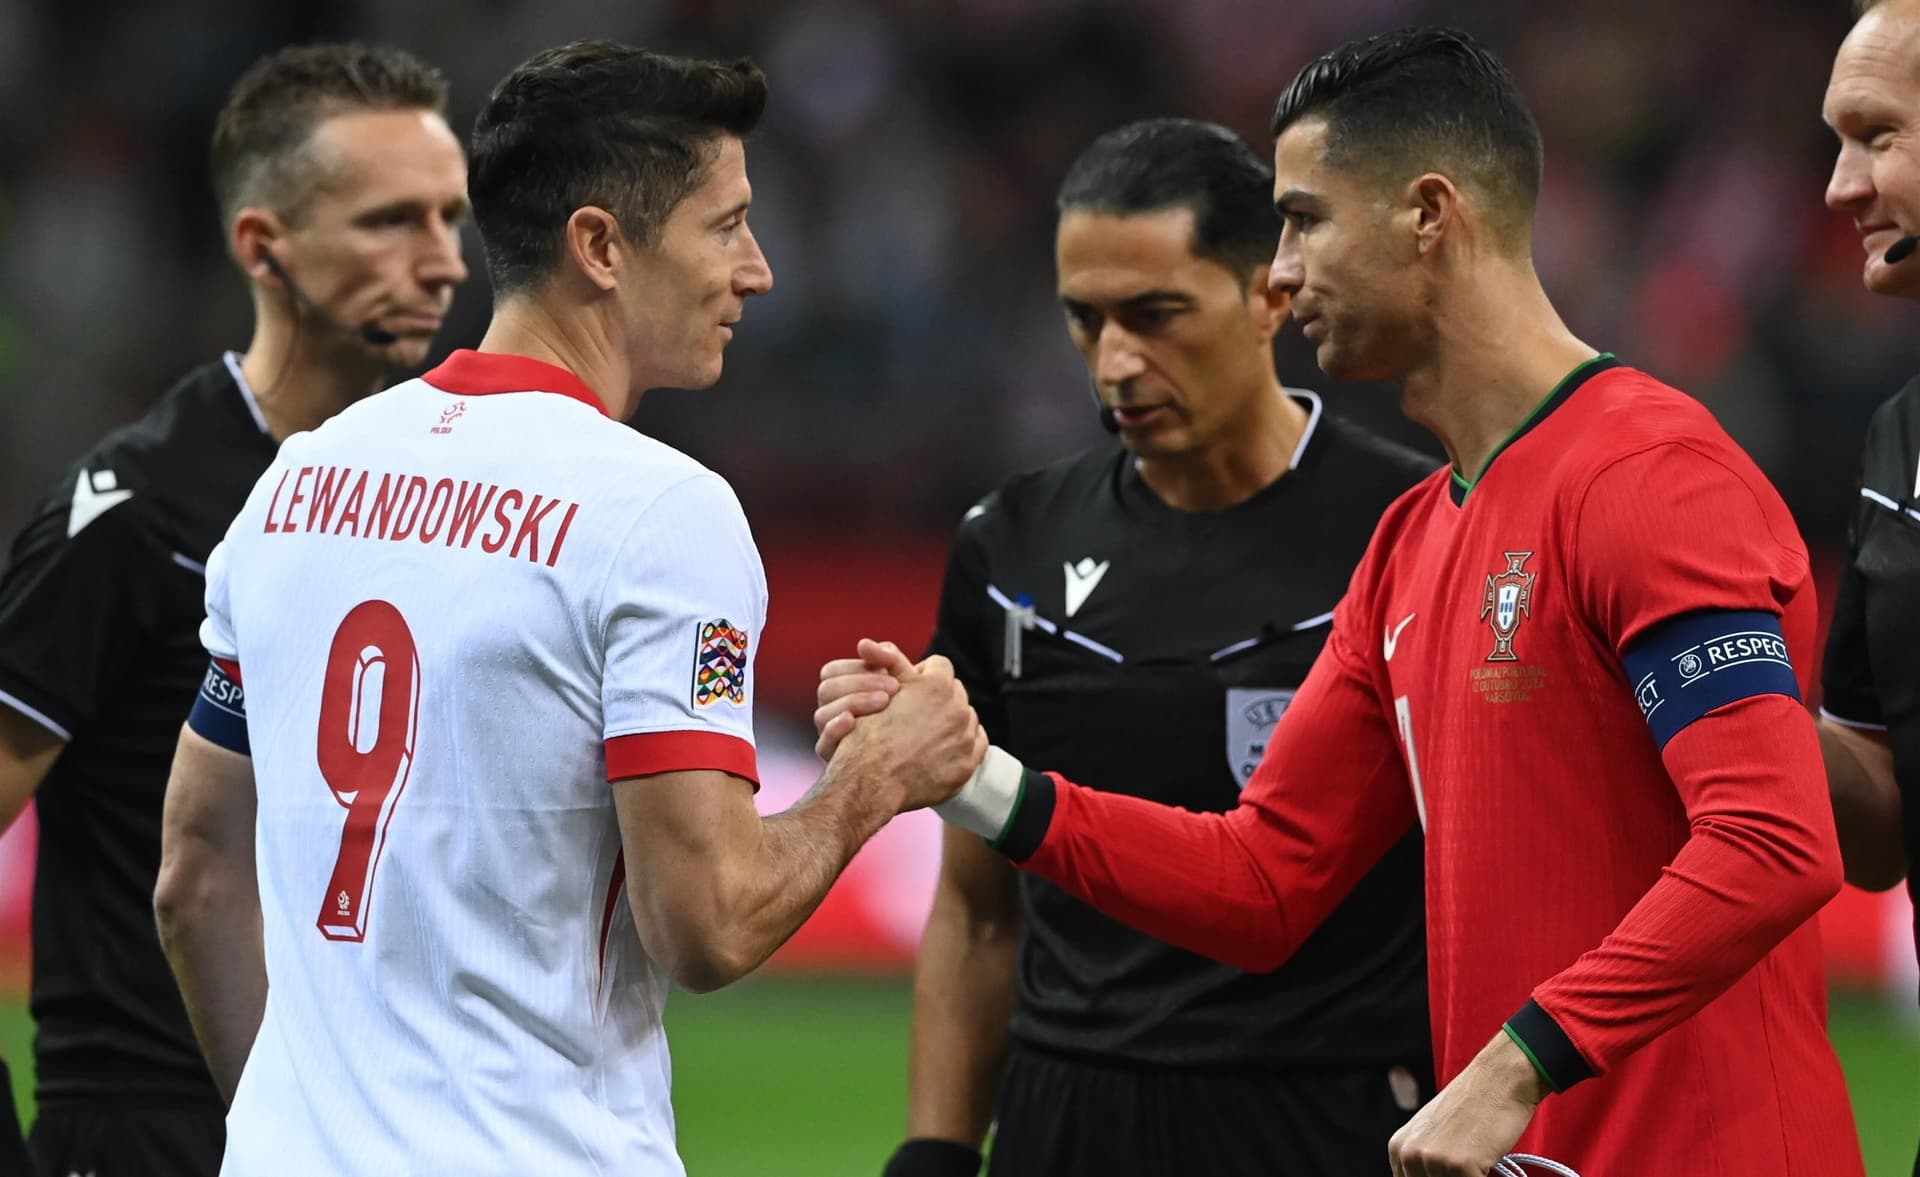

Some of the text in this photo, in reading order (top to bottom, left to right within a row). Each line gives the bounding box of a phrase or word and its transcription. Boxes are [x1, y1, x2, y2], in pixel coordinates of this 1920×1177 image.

[264, 466, 579, 567] LEWANDOWSKI
[1707, 637, 1789, 665] RESPECT
[317, 599, 421, 943] 9
